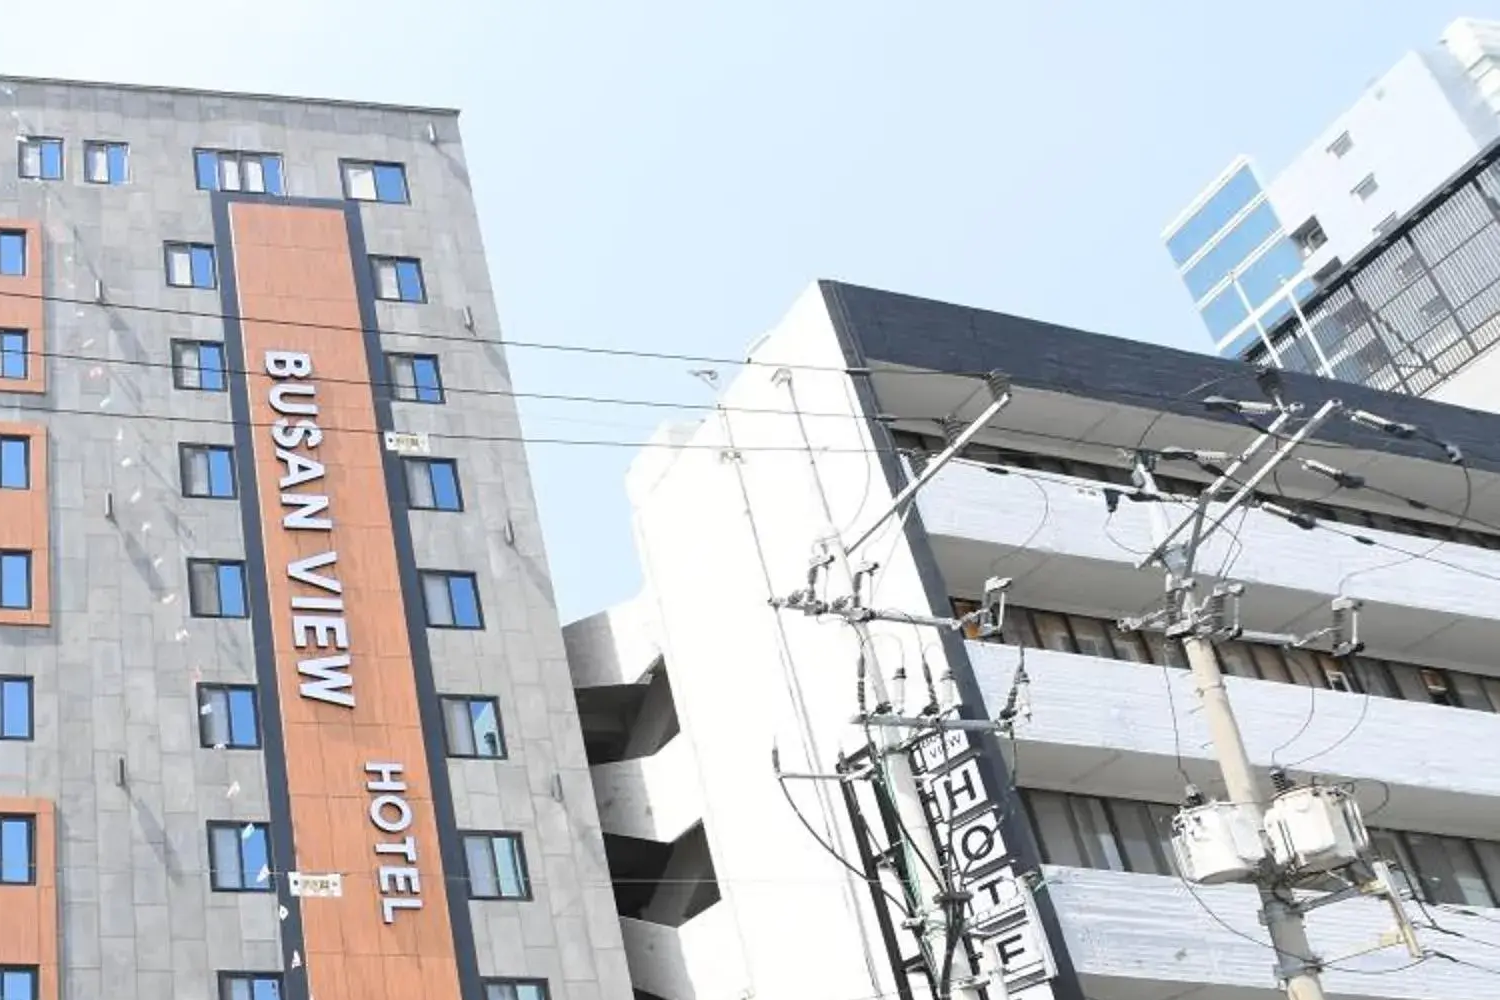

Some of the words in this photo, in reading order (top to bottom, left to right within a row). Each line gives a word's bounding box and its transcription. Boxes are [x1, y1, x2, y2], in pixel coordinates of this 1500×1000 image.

[264, 350, 333, 532] BUSAN
[286, 550, 356, 709] VIEW
[364, 760, 424, 925] HOTEL
